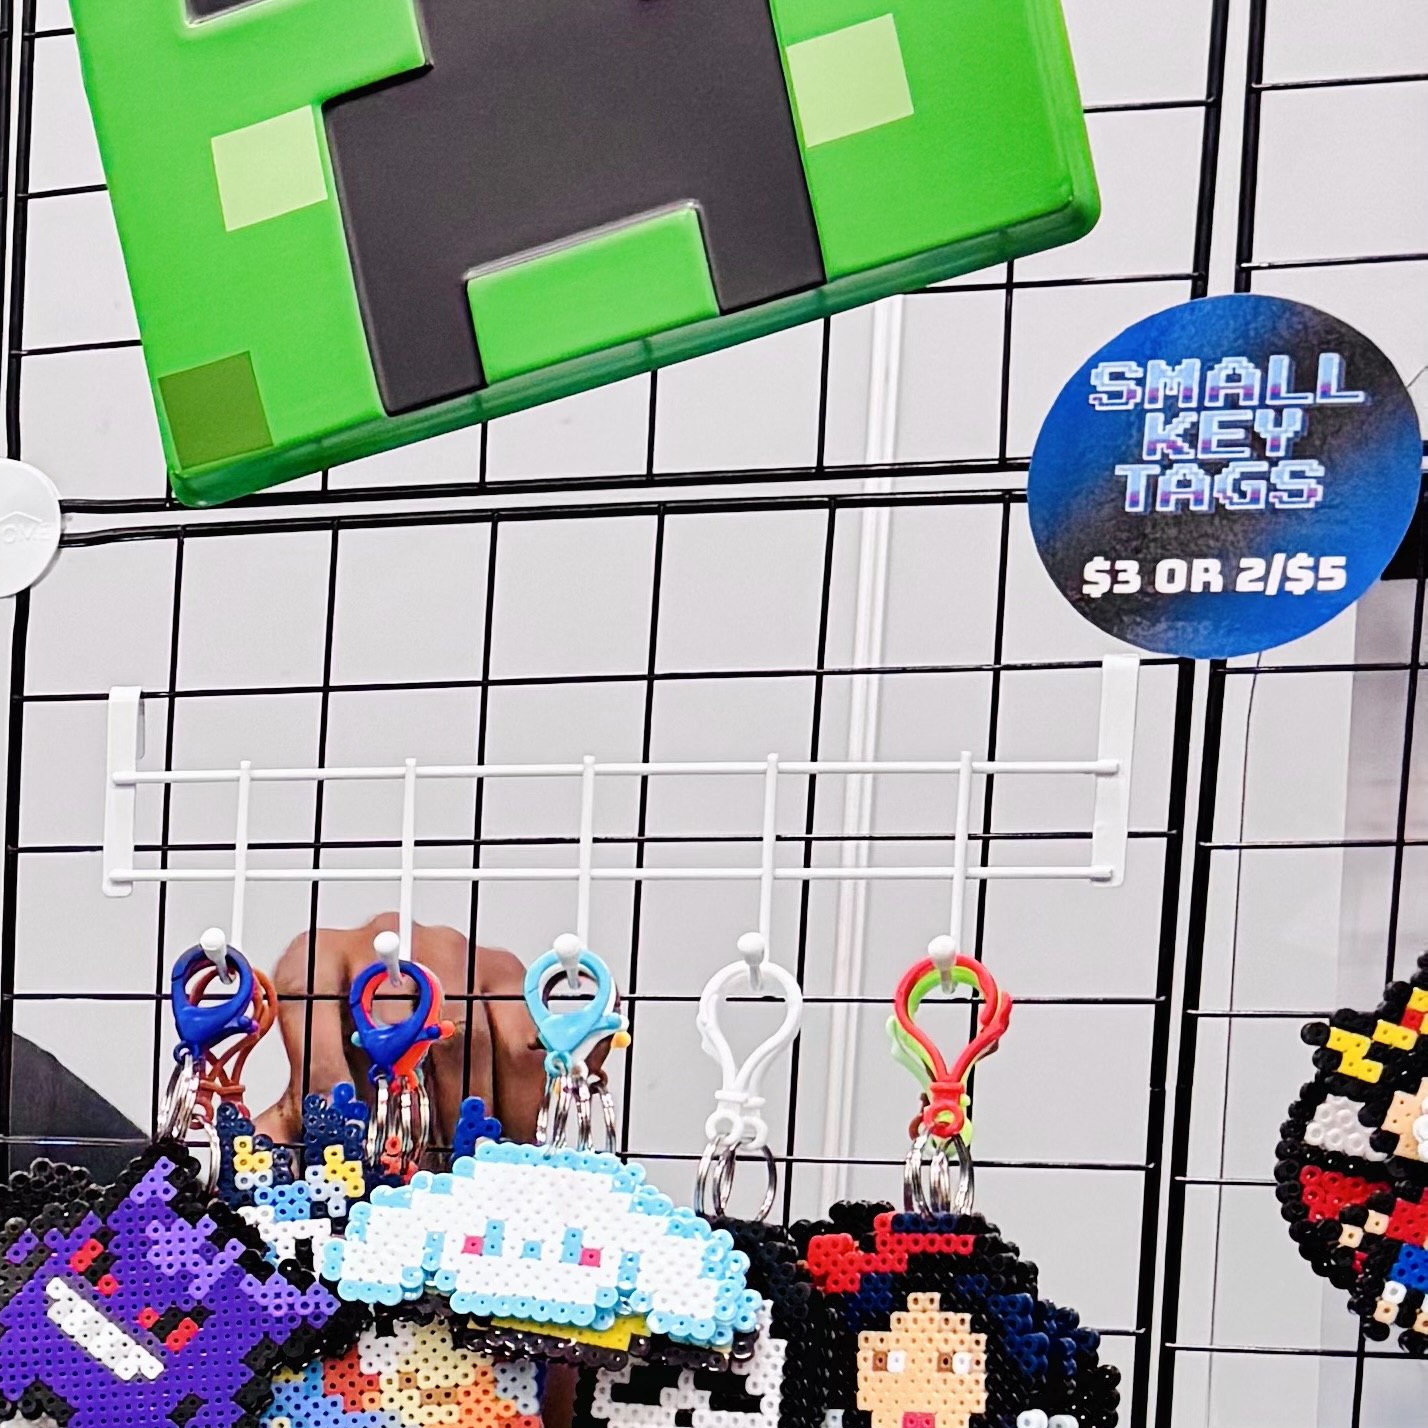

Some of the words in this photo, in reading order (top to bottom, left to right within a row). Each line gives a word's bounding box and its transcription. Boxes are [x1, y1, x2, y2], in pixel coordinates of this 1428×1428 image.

[1088, 353, 1366, 412] SMALL
[1142, 408, 1305, 461] KEY
[1115, 459, 1326, 513] TAGS
[1082, 556, 1142, 599] $3
[1154, 558, 1224, 594] OR
[1235, 552, 1347, 596] 2/$5
